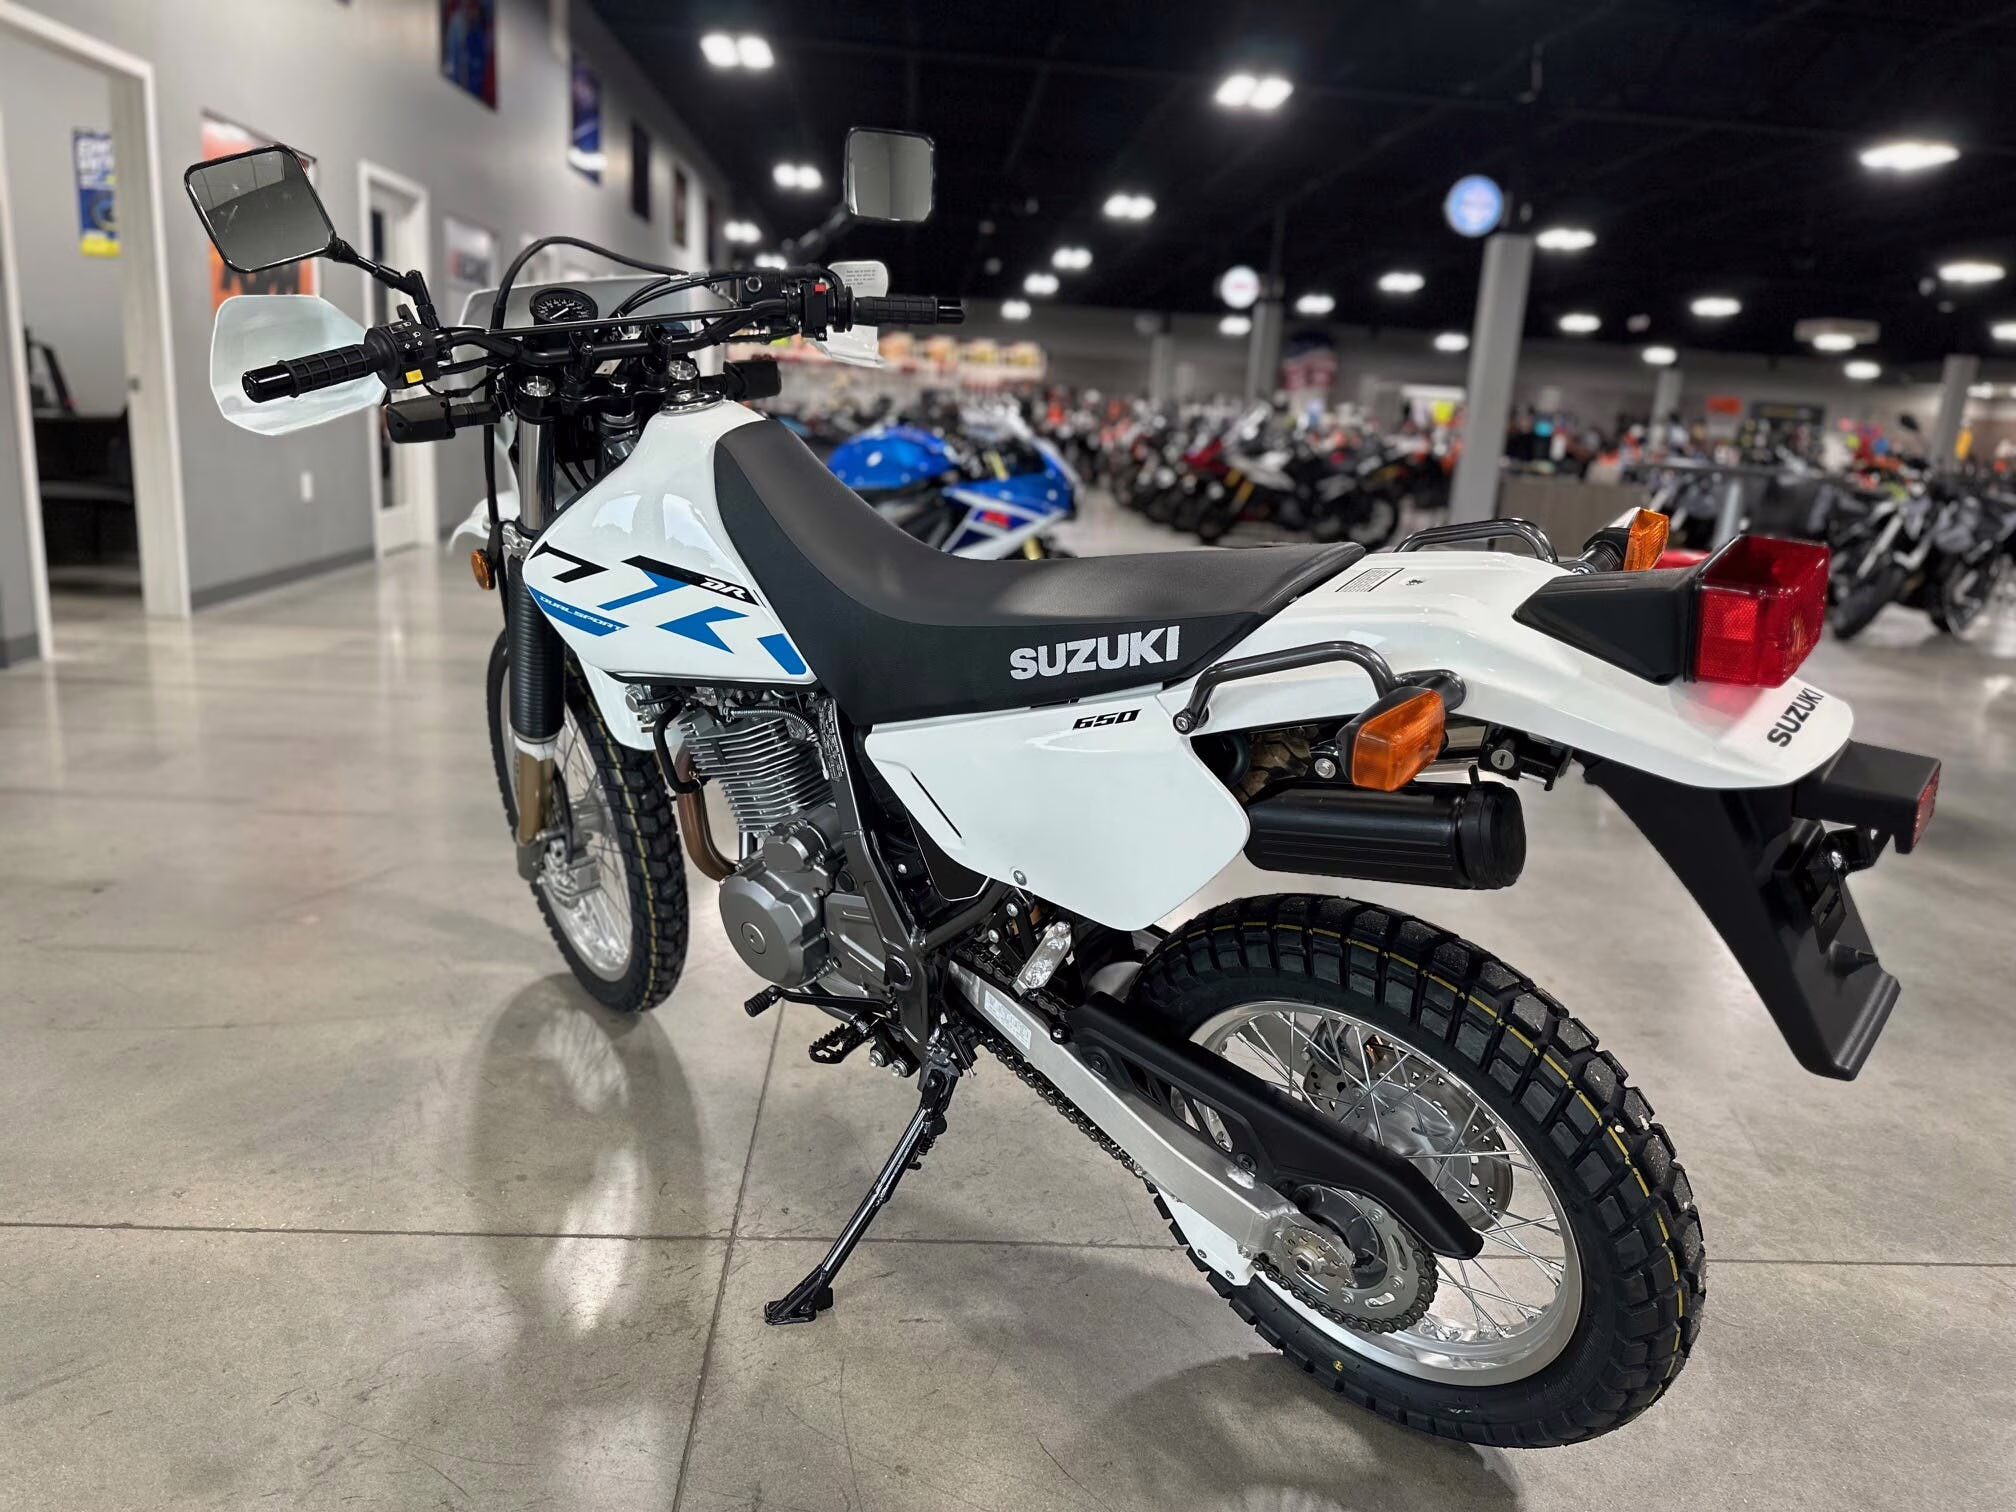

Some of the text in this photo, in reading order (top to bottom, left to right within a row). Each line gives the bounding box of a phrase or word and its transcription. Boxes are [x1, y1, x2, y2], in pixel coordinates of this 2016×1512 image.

[700, 577, 746, 600] DR
[540, 595, 621, 631] DUAL SPORT
[1010, 625, 1180, 680] SUZUKI
[1072, 709, 1142, 730] 650
[1767, 688, 1824, 747] SUZUKI
